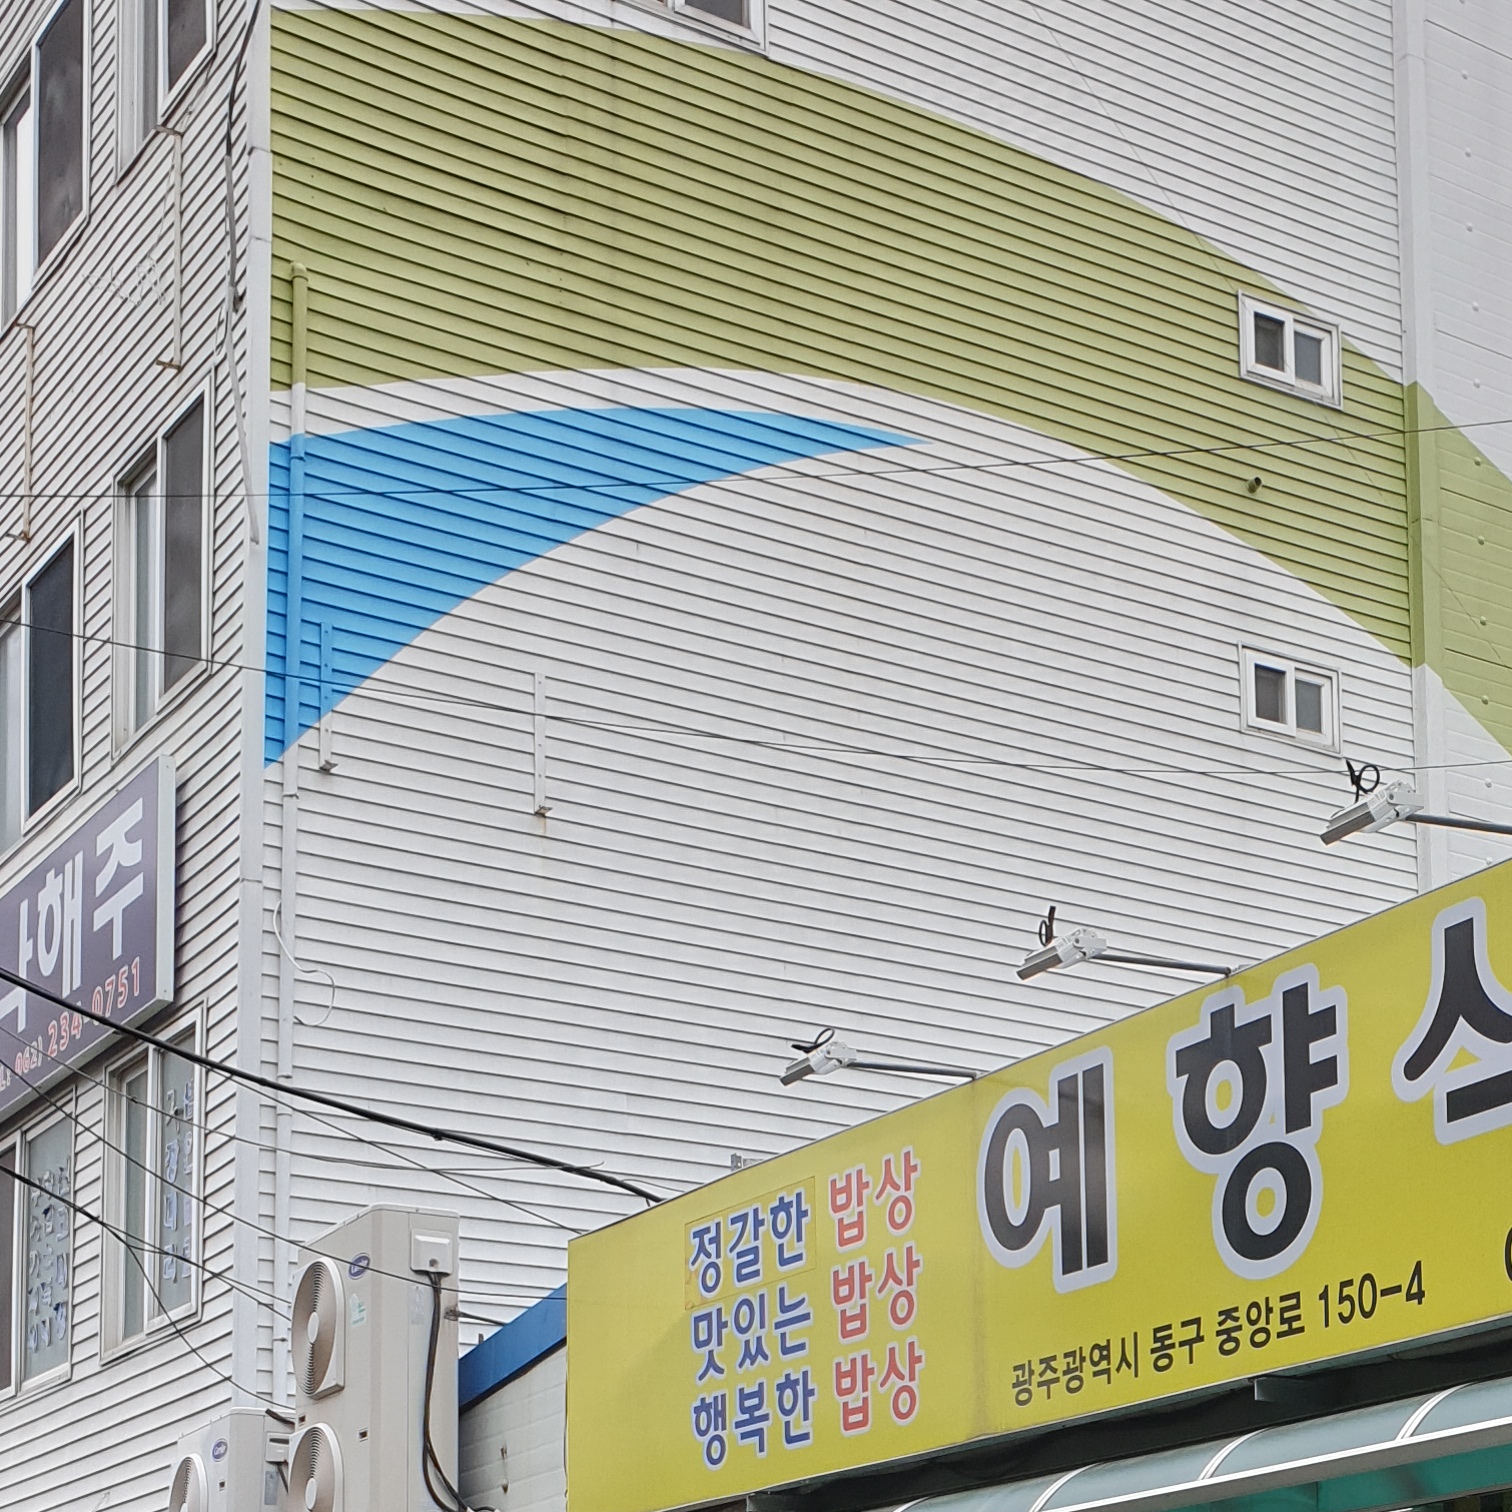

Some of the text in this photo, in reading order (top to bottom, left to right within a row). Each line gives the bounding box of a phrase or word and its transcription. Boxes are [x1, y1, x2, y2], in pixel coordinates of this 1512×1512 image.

[690, 1149, 918, 1294] 정갈한 밥상
[692, 1245, 921, 1382] 맛있는 밥상
[1011, 1260, 1426, 1408] 광주광역시 동구 중앙로 150-4
[693, 1340, 923, 1466] 행복한 밥상
